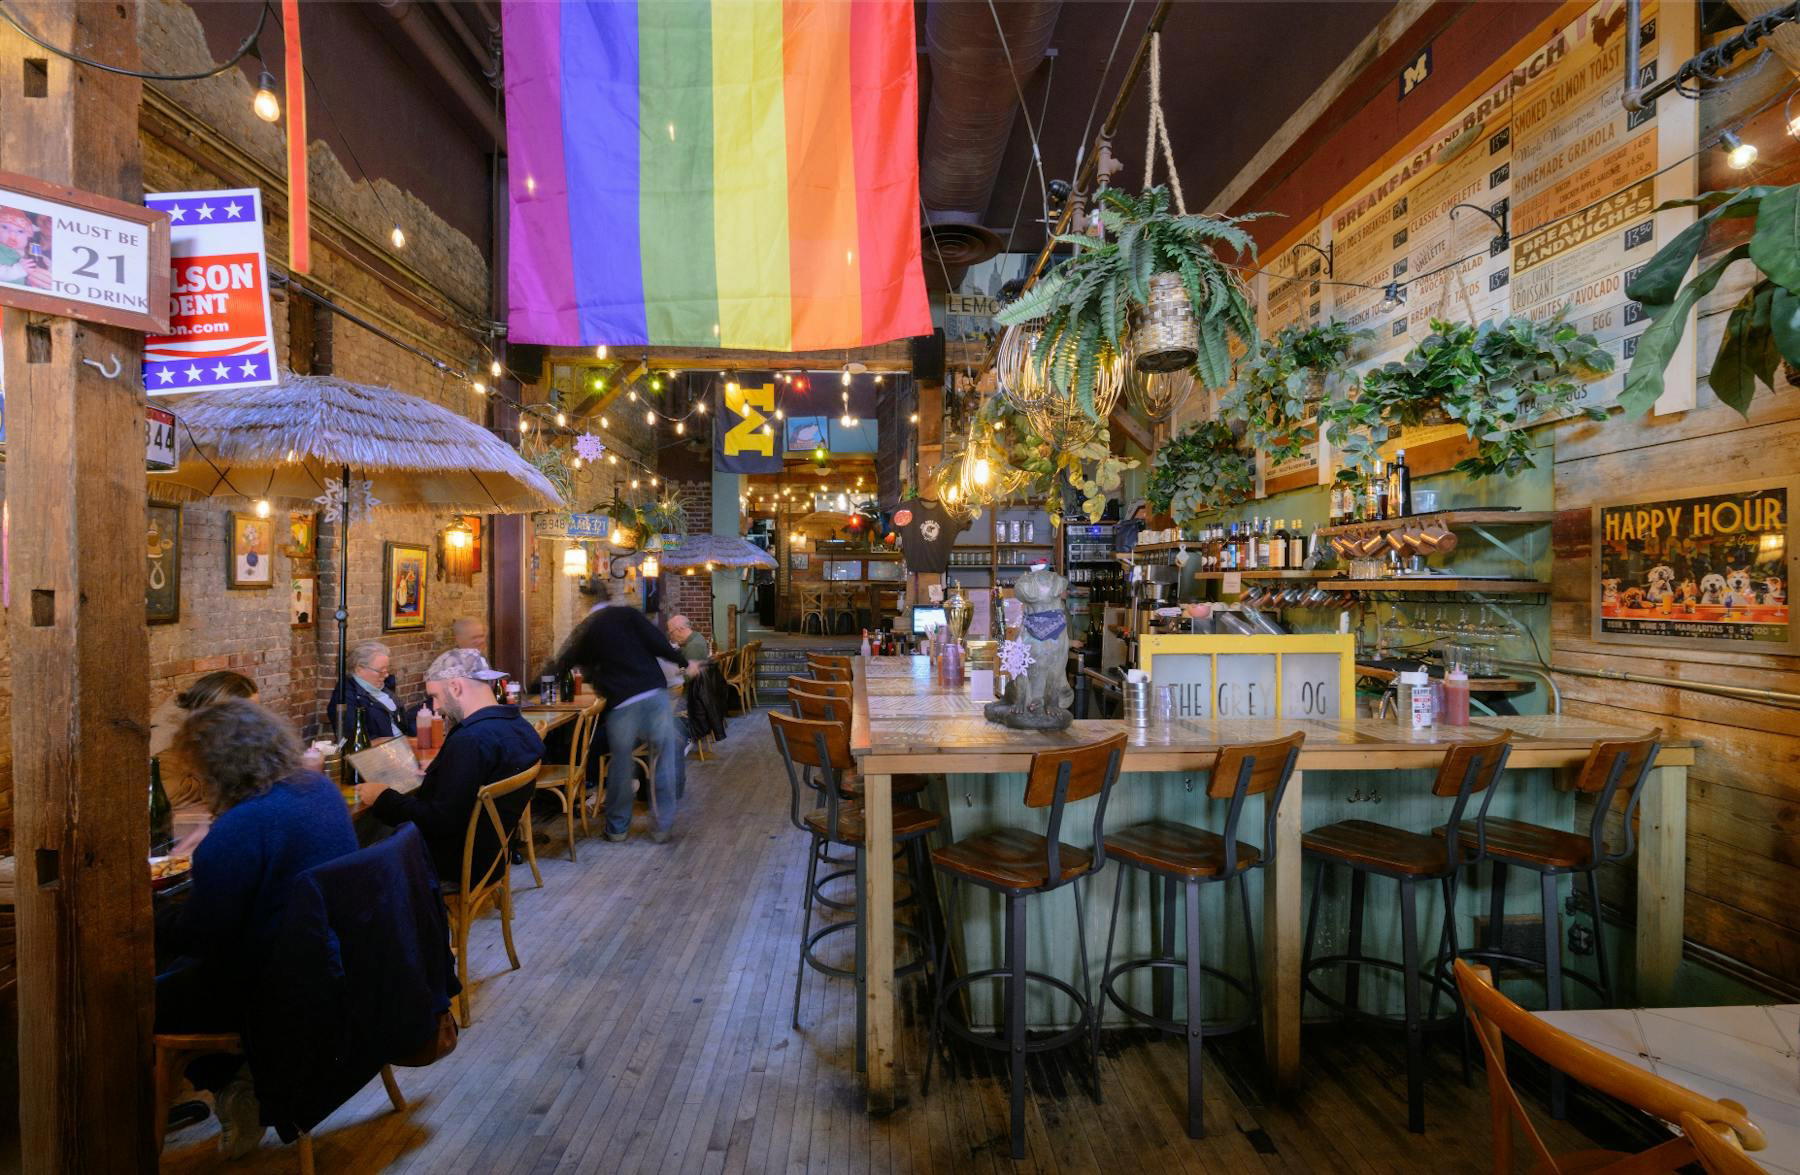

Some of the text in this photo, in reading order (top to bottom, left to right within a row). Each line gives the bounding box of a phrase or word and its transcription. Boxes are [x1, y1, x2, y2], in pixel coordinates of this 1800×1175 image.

[1404, 53, 1427, 95] M
[1514, 44, 1621, 137] SMOKED SALMON TOAST
[1337, 144, 1434, 233] BREAKFAST
[1463, 35, 1565, 134] BRUNCH
[1514, 123, 1615, 194] HOMEMADE GRANOLA
[1411, 206, 1438, 233] CLASSIC
[1441, 179, 1482, 214] OMELETTE
[1523, 184, 1643, 254] BREAKFAST
[57, 218, 139, 247] MUST BE
[1516, 196, 1651, 270] SANDWICHES
[72, 246, 125, 284] 21
[1415, 240, 1446, 273] OMELETTE
[54, 280, 148, 309] TO DRINK
[170, 263, 254, 293] LSON
[1512, 276, 1554, 310] CROISSANT
[170, 293, 229, 317] DENT
[1530, 299, 1561, 321] WHITES
[1576, 275, 1620, 305] AVOCADO
[169, 322, 229, 336] on.com
[1592, 311, 1612, 331] EGG
[1605, 498, 1783, 541] HAPPY HOUR
[1675, 623, 1723, 634] MARGARITAS
[1168, 683, 1202, 717] THE
